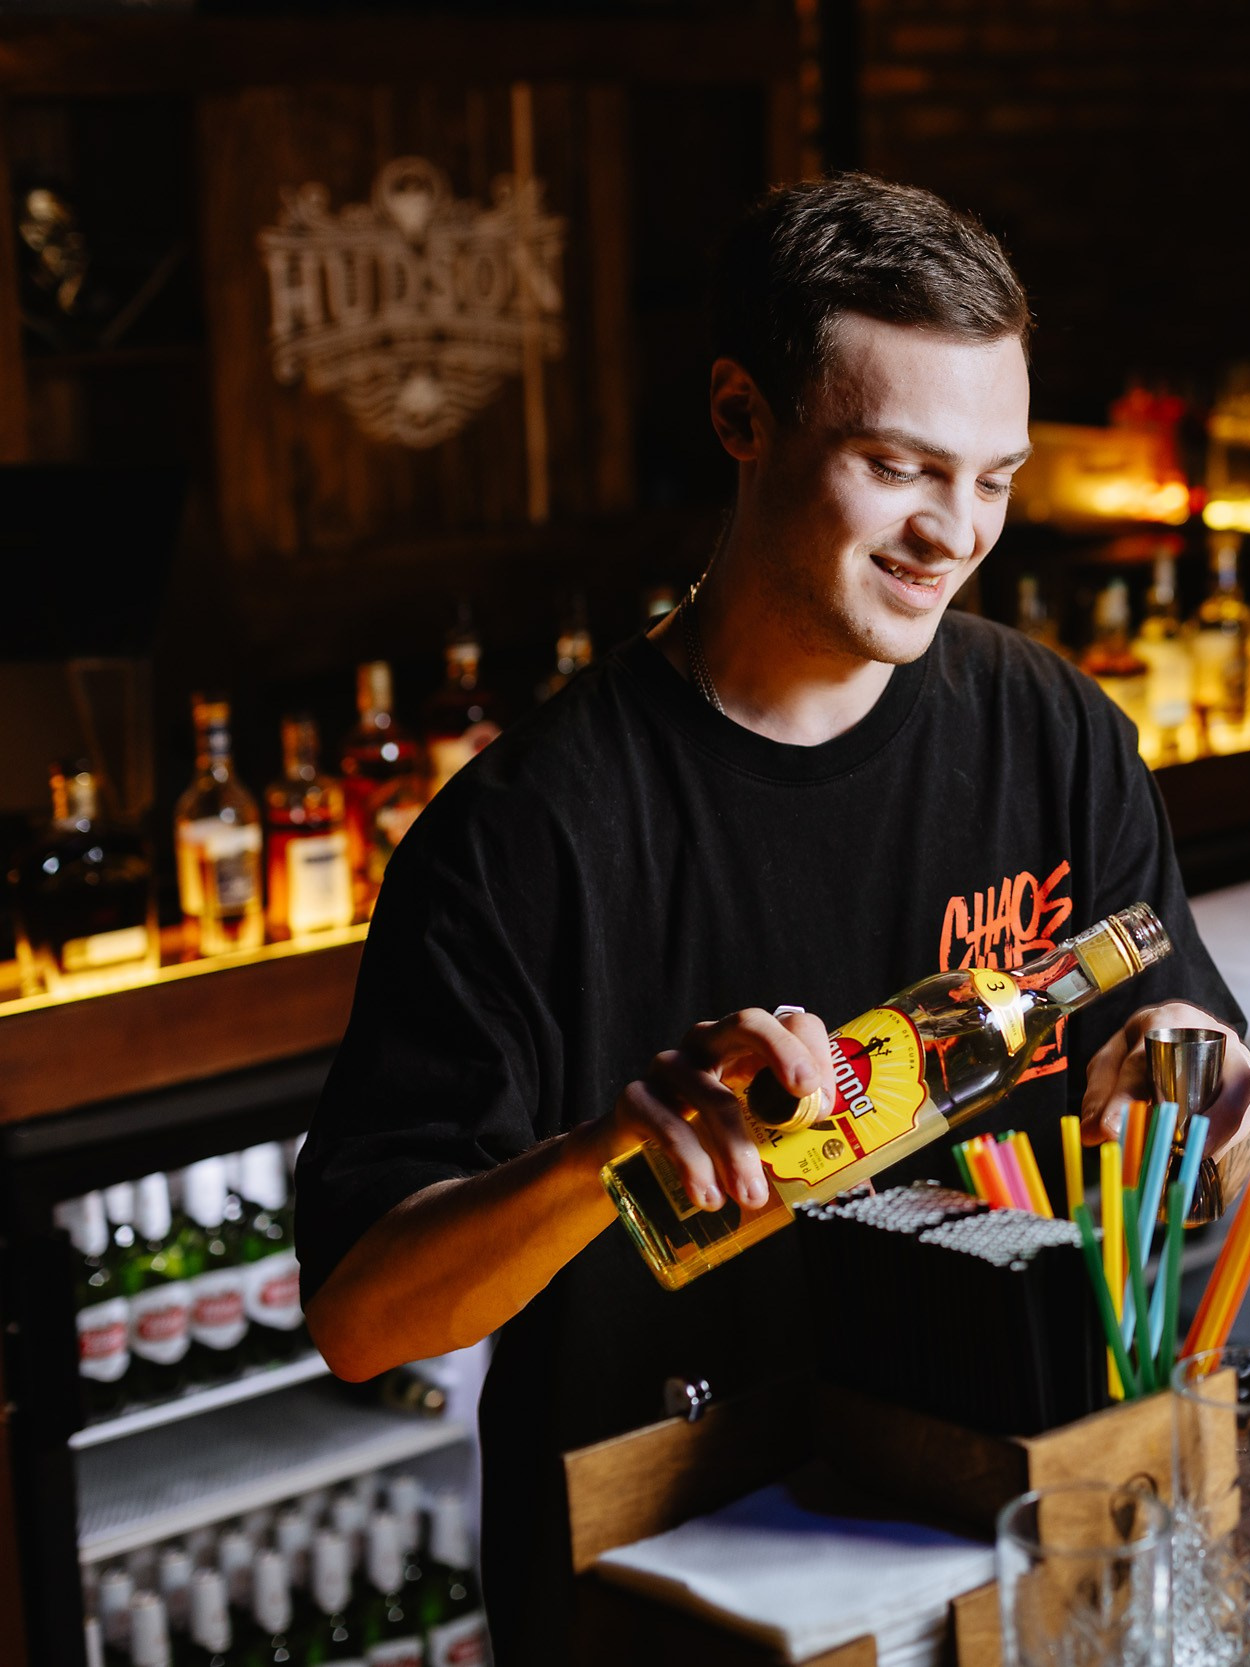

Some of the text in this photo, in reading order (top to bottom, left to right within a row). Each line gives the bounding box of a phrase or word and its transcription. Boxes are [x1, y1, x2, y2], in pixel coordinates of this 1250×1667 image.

[265, 234, 562, 336] HUDSON
[940, 860, 1073, 972] CHAOS
[986, 981, 1005, 992] 3
[889, 1014, 900, 1024] RON
[902, 1029, 909, 1039] DE
